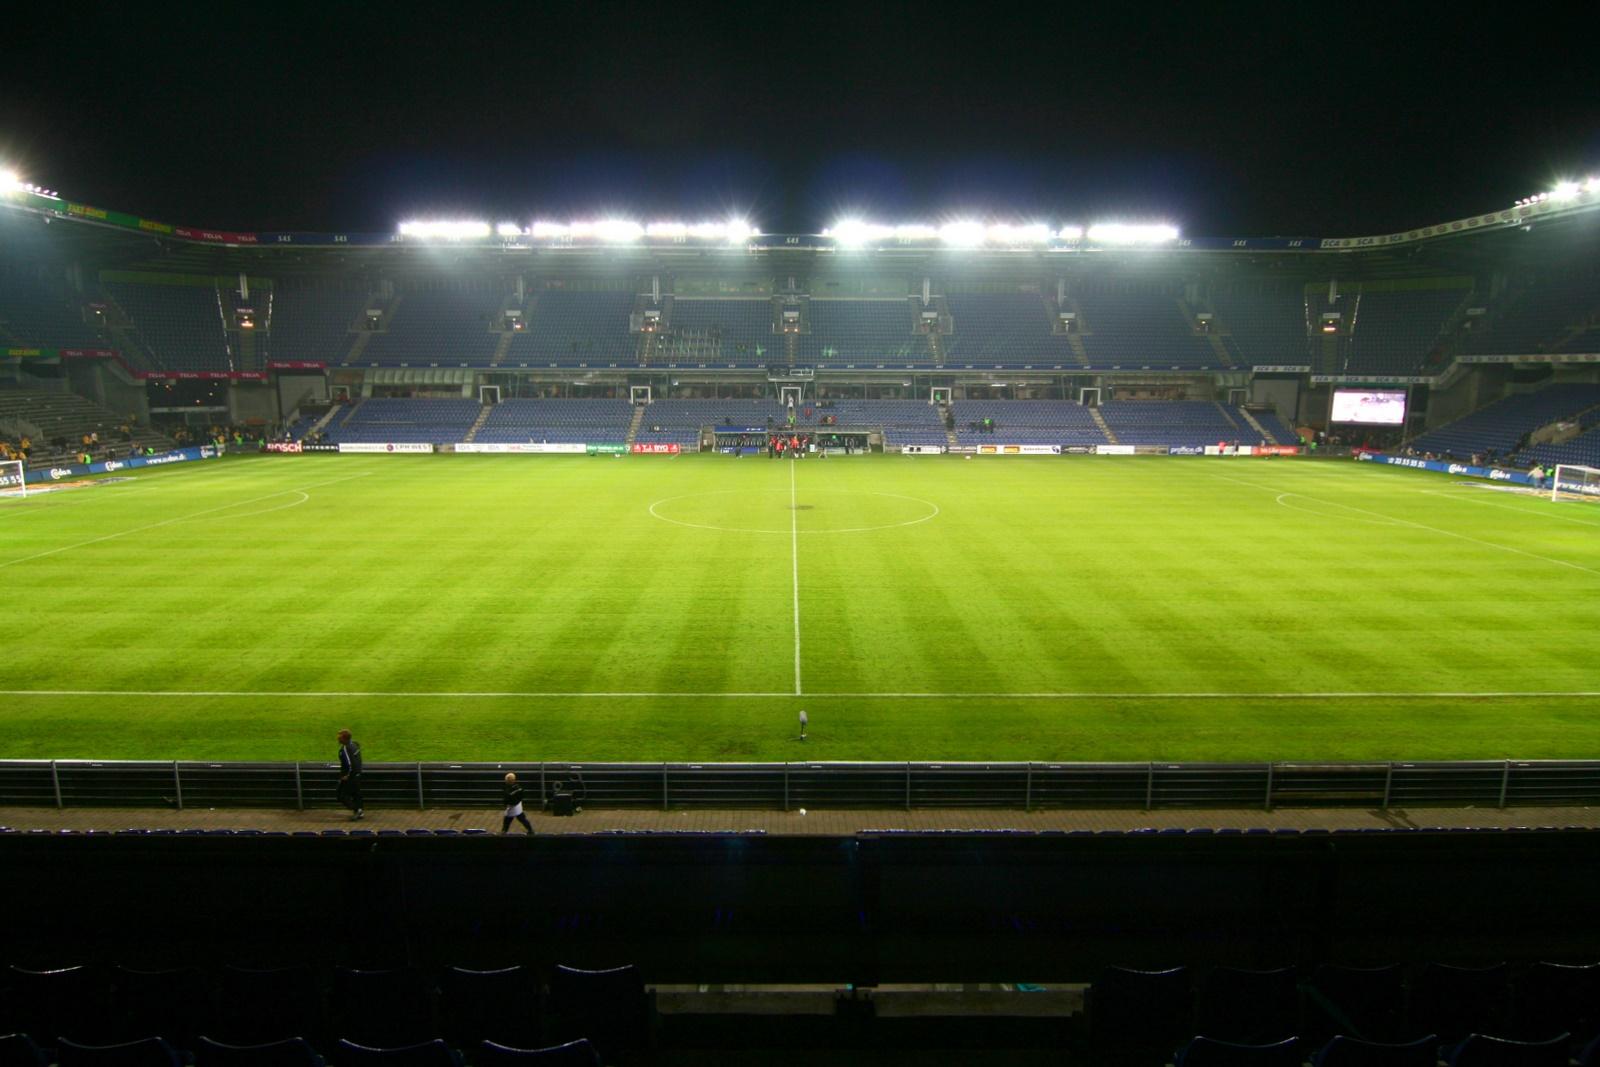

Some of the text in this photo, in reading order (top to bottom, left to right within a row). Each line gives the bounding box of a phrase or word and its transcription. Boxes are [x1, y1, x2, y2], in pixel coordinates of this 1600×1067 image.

[202, 232, 223, 240] TELIA
[1231, 239, 1247, 247] SAS
[1287, 239, 1303, 247] SAS
[1322, 240, 1340, 248] SCA
[1356, 238, 1374, 246] SCA
